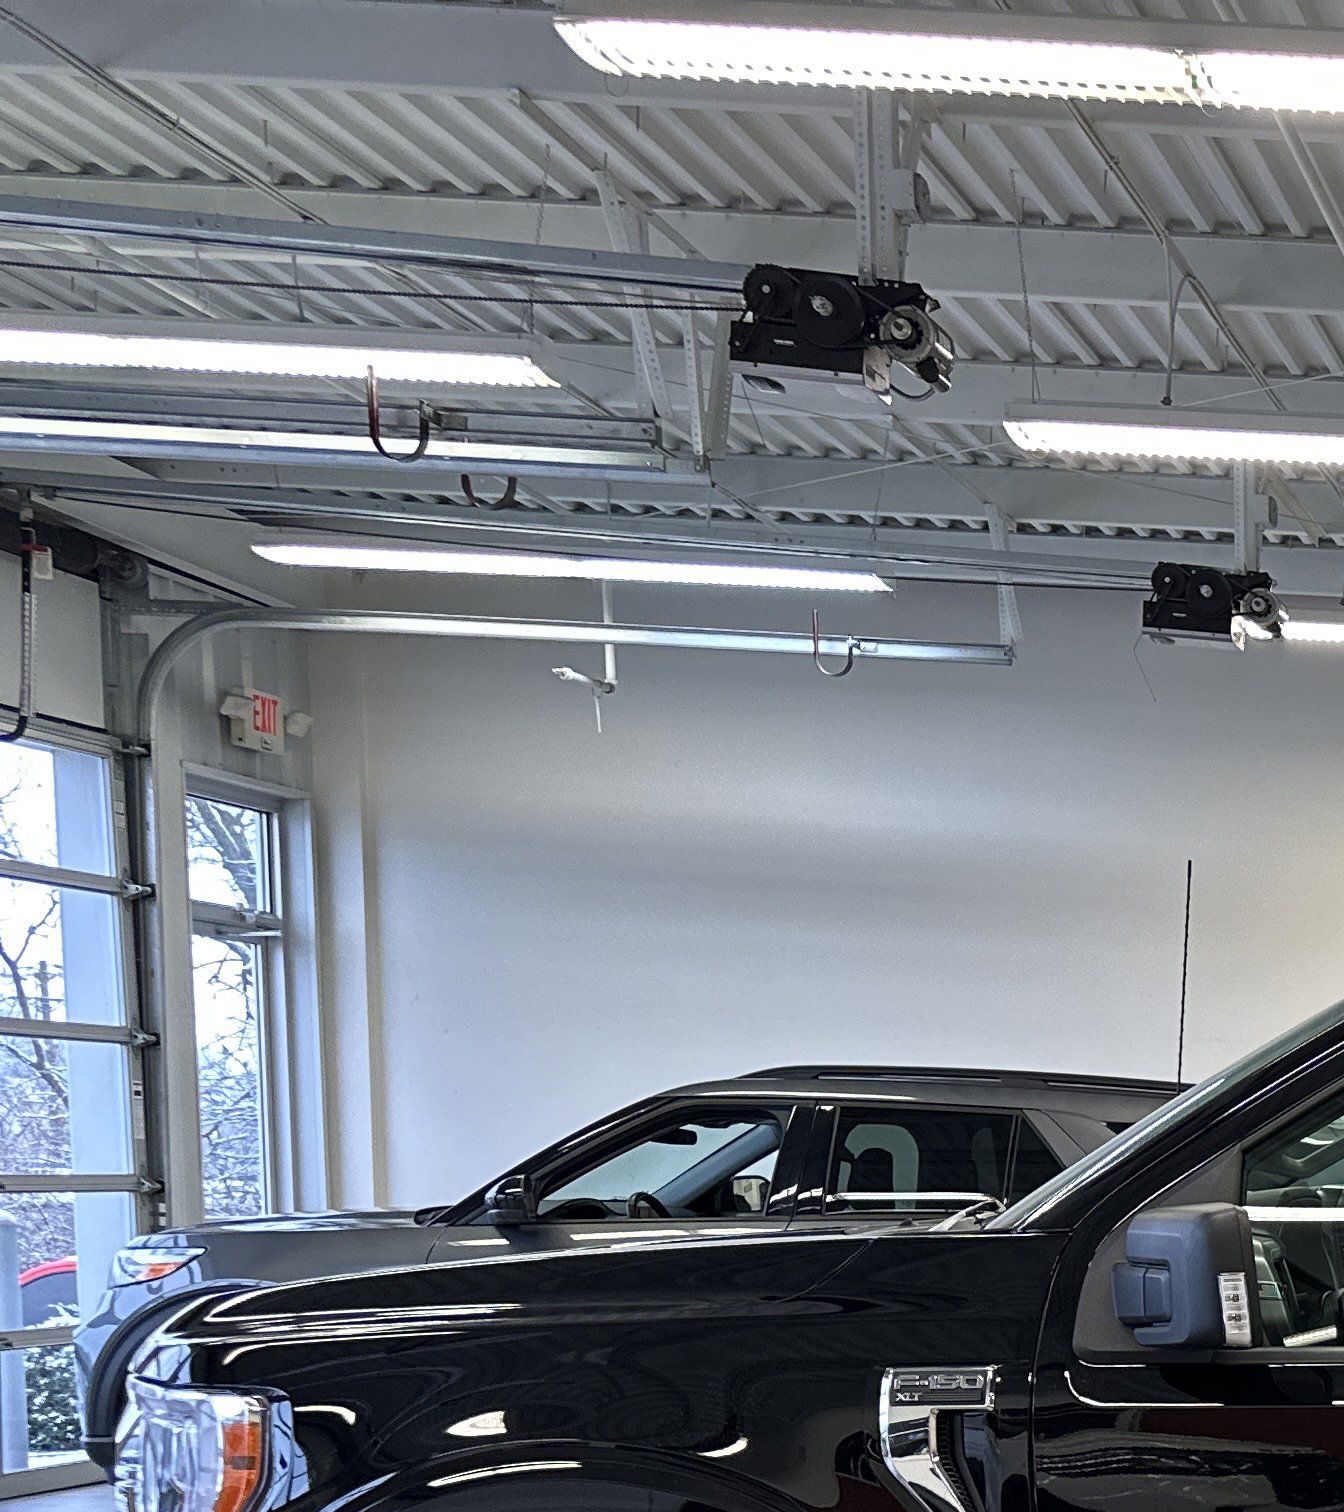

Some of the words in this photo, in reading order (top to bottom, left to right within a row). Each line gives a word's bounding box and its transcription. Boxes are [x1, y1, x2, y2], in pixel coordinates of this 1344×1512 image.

[253, 694, 278, 736] EXIT
[894, 1375, 984, 1389] F-150
[895, 1392, 922, 1401] XLT
